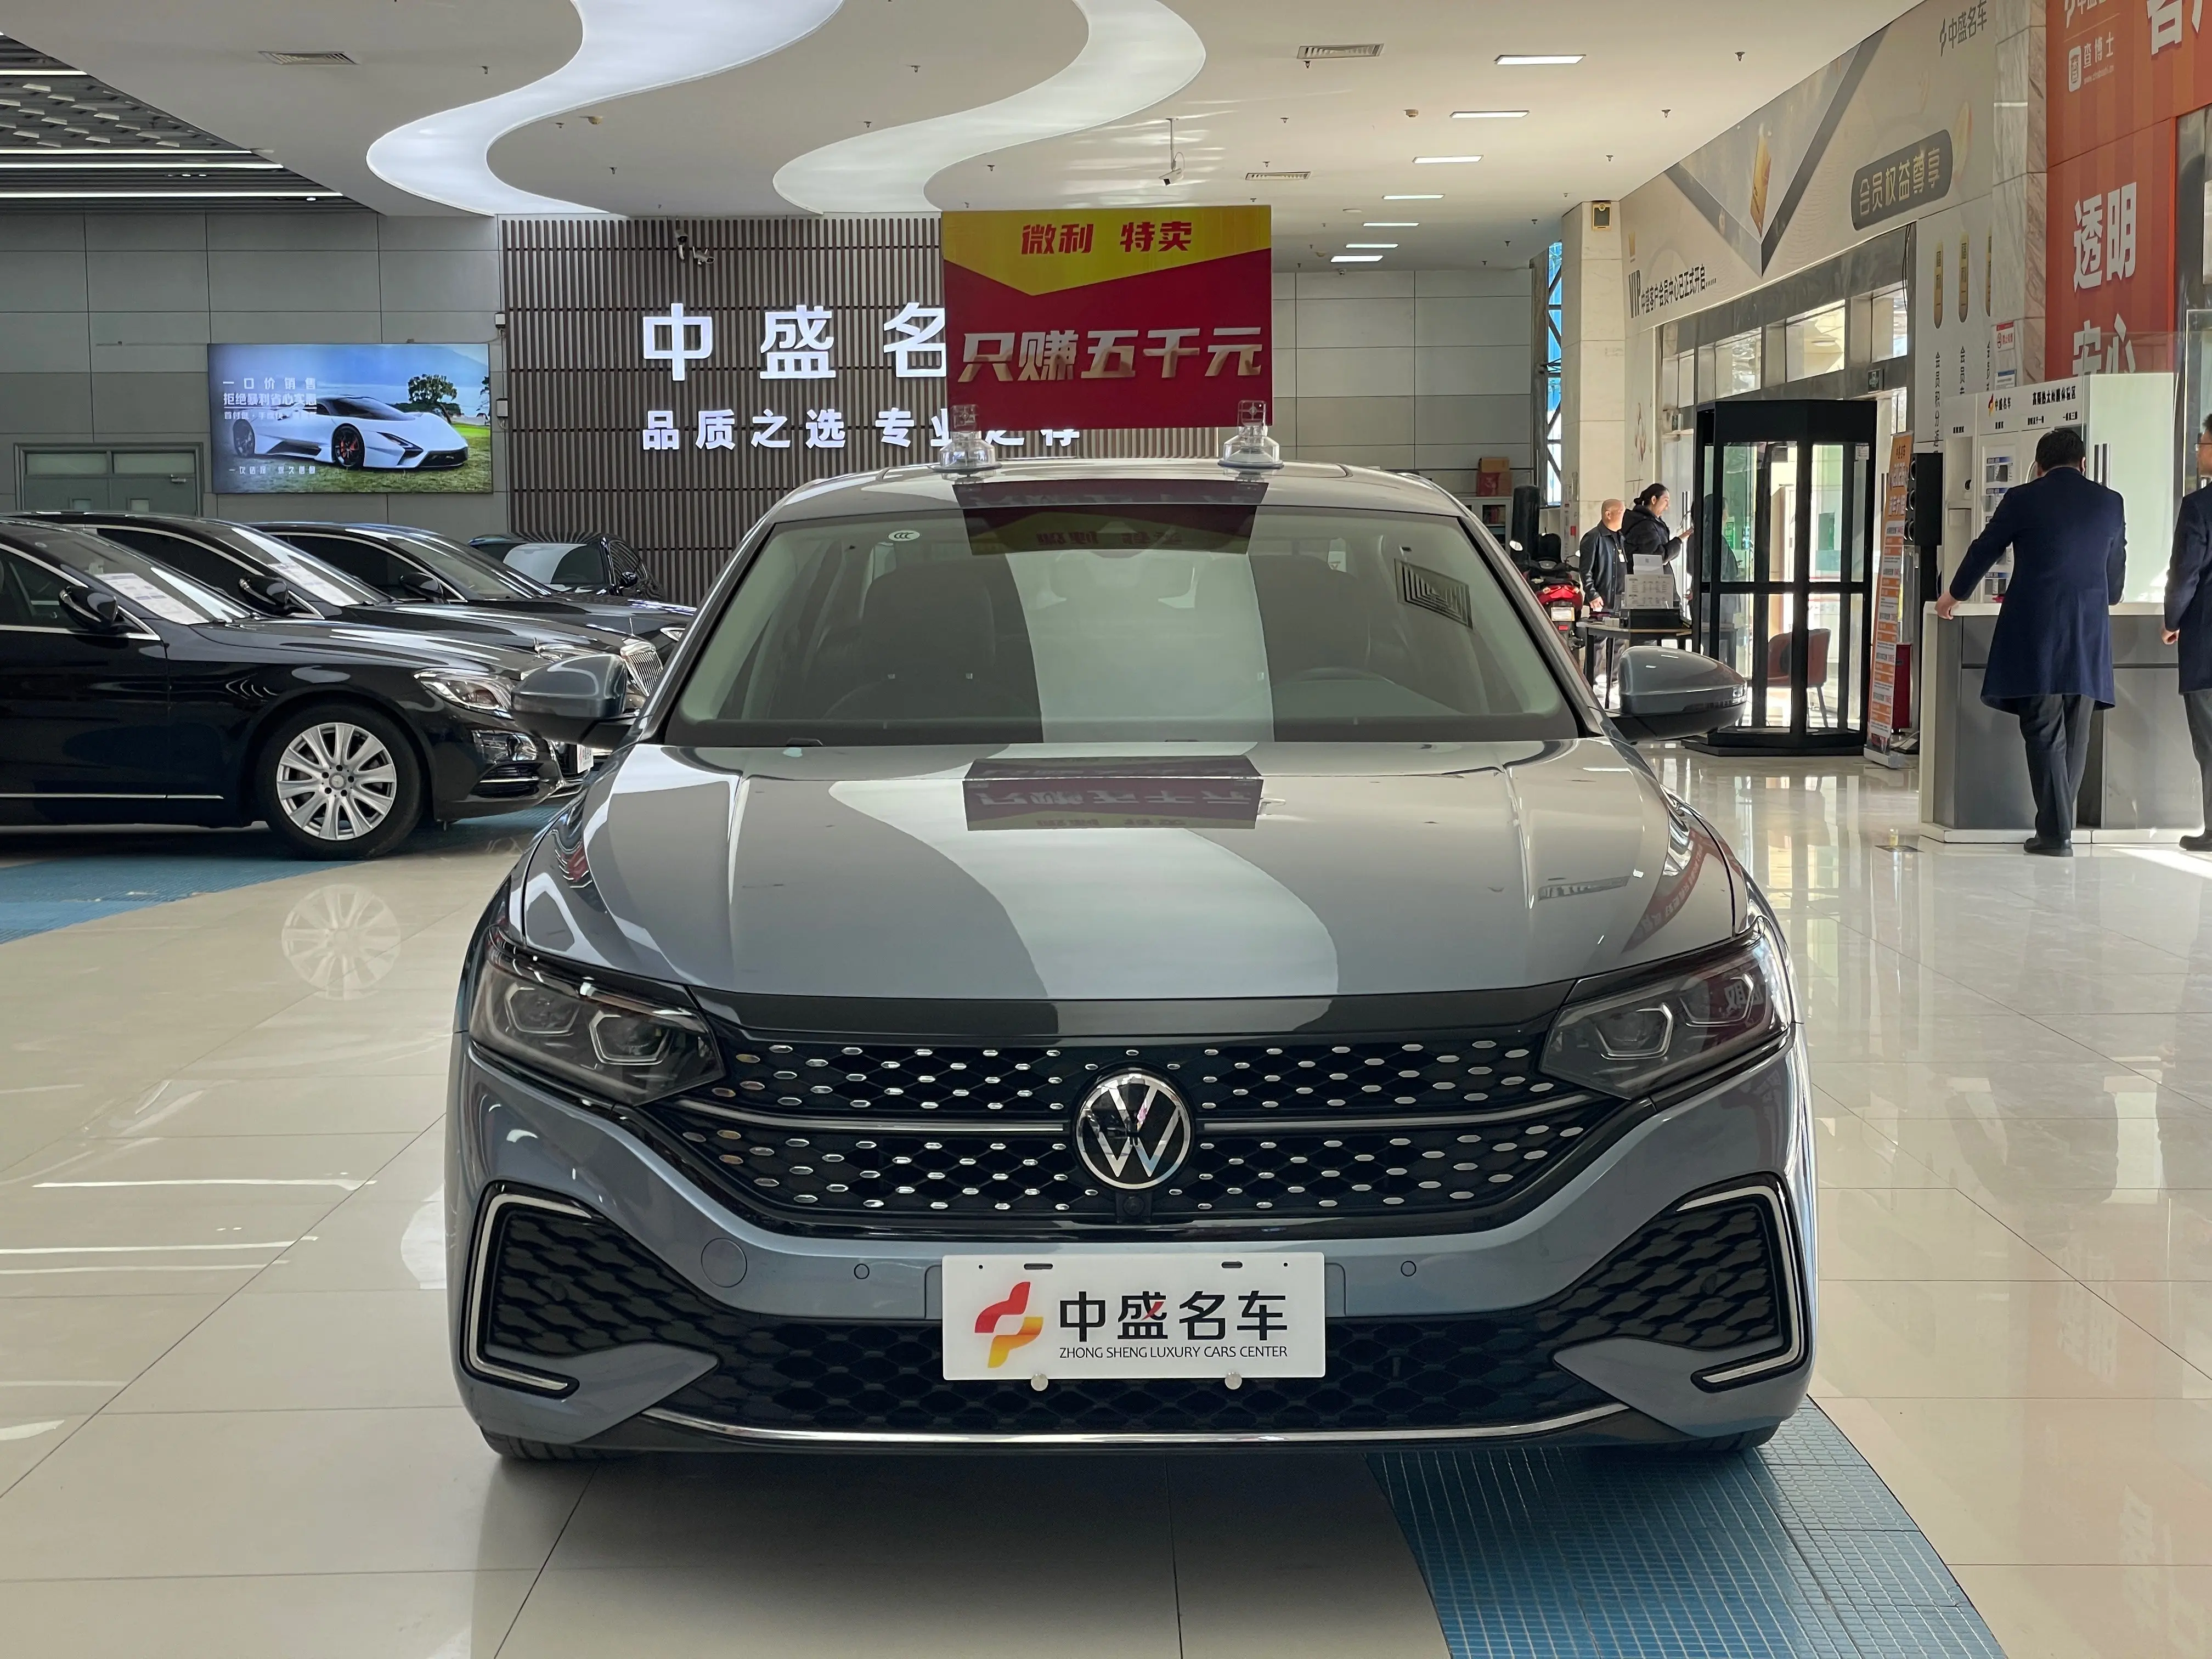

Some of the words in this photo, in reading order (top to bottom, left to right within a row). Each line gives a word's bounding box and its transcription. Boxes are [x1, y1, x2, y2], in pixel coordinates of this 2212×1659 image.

[1949, 1, 1987, 49] 中盛名车
[2084, 32, 2114, 69] 查博士
[1860, 148, 1940, 217] 会员权益尊享
[1021, 223, 1094, 255] 微利
[1120, 221, 1192, 252] 特卖
[2074, 182, 2136, 293] 透明
[1628, 269, 1641, 319] VIP
[957, 328, 1262, 382] 只赚五千元
[223, 377, 316, 390] 一口价销售
[642, 409, 847, 450] 品质之选
[1059, 1290, 1288, 1342] 中盛名车
[1059, 1347, 1103, 1358] ZHONG
[1107, 1347, 1148, 1358] SHENG
[1150, 1346, 1201, 1358] LUXURY
[1204, 1346, 1237, 1357] CARS
[1239, 1345, 1288, 1357] CENTER
